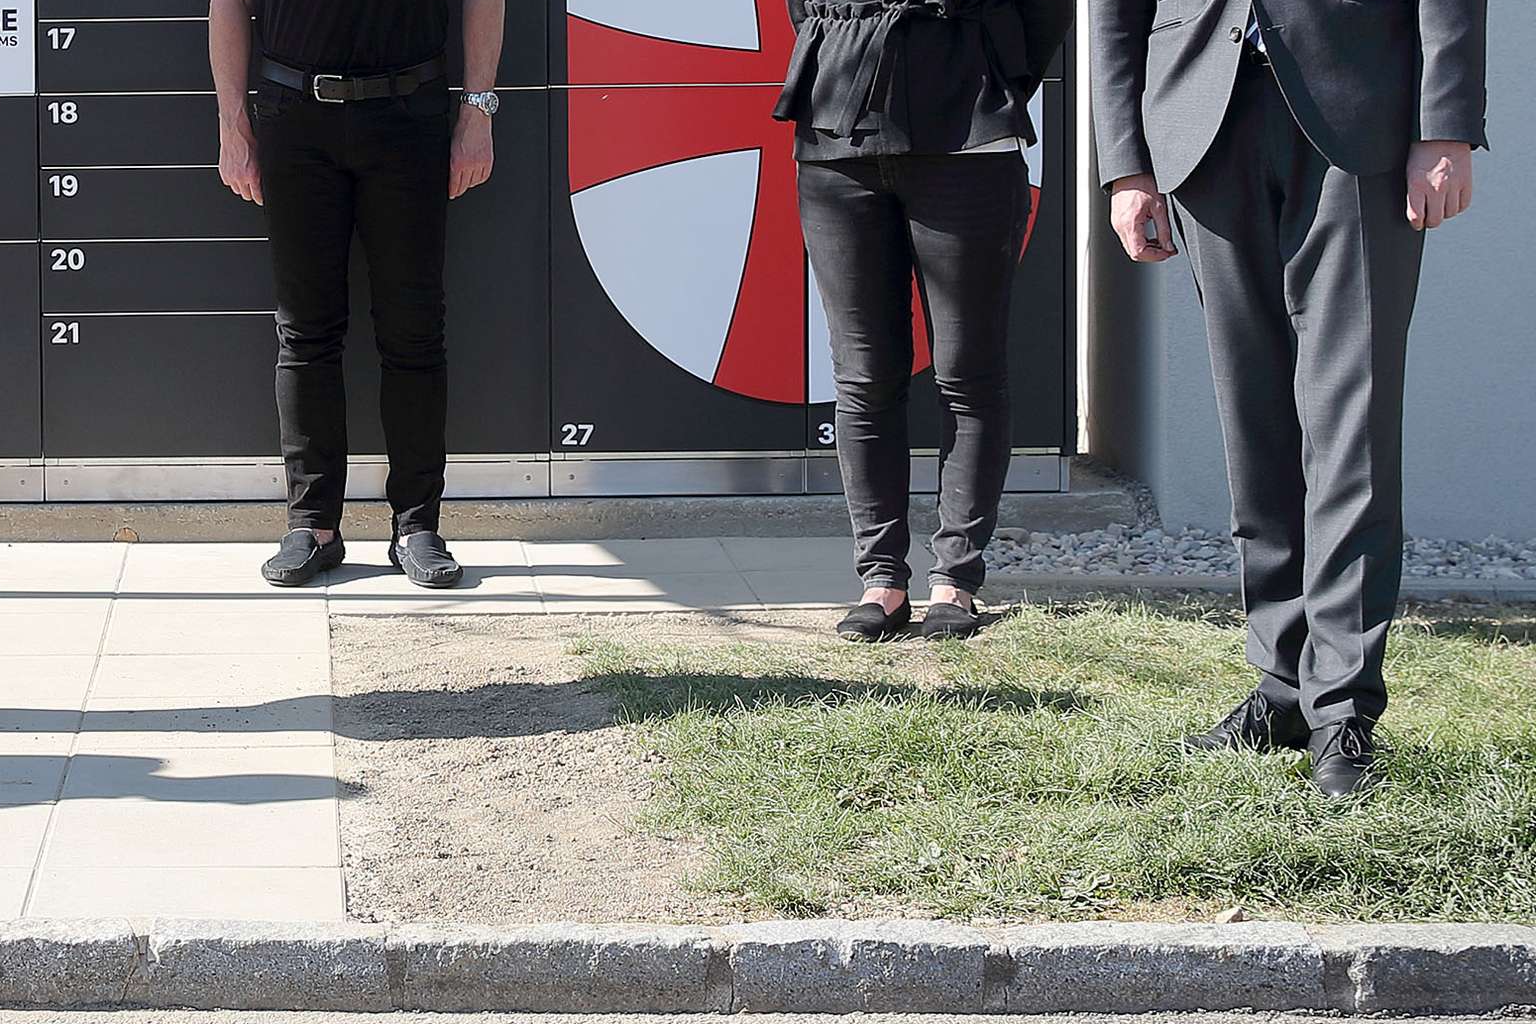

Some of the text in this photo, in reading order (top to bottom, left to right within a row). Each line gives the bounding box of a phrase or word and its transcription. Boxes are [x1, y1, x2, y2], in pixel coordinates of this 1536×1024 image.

[47, 27, 76, 50] 17
[47, 101, 78, 124] 18
[49, 174, 78, 197] 19
[51, 248, 85, 271] 20
[51, 322, 79, 344] 21
[561, 423, 594, 445] 27
